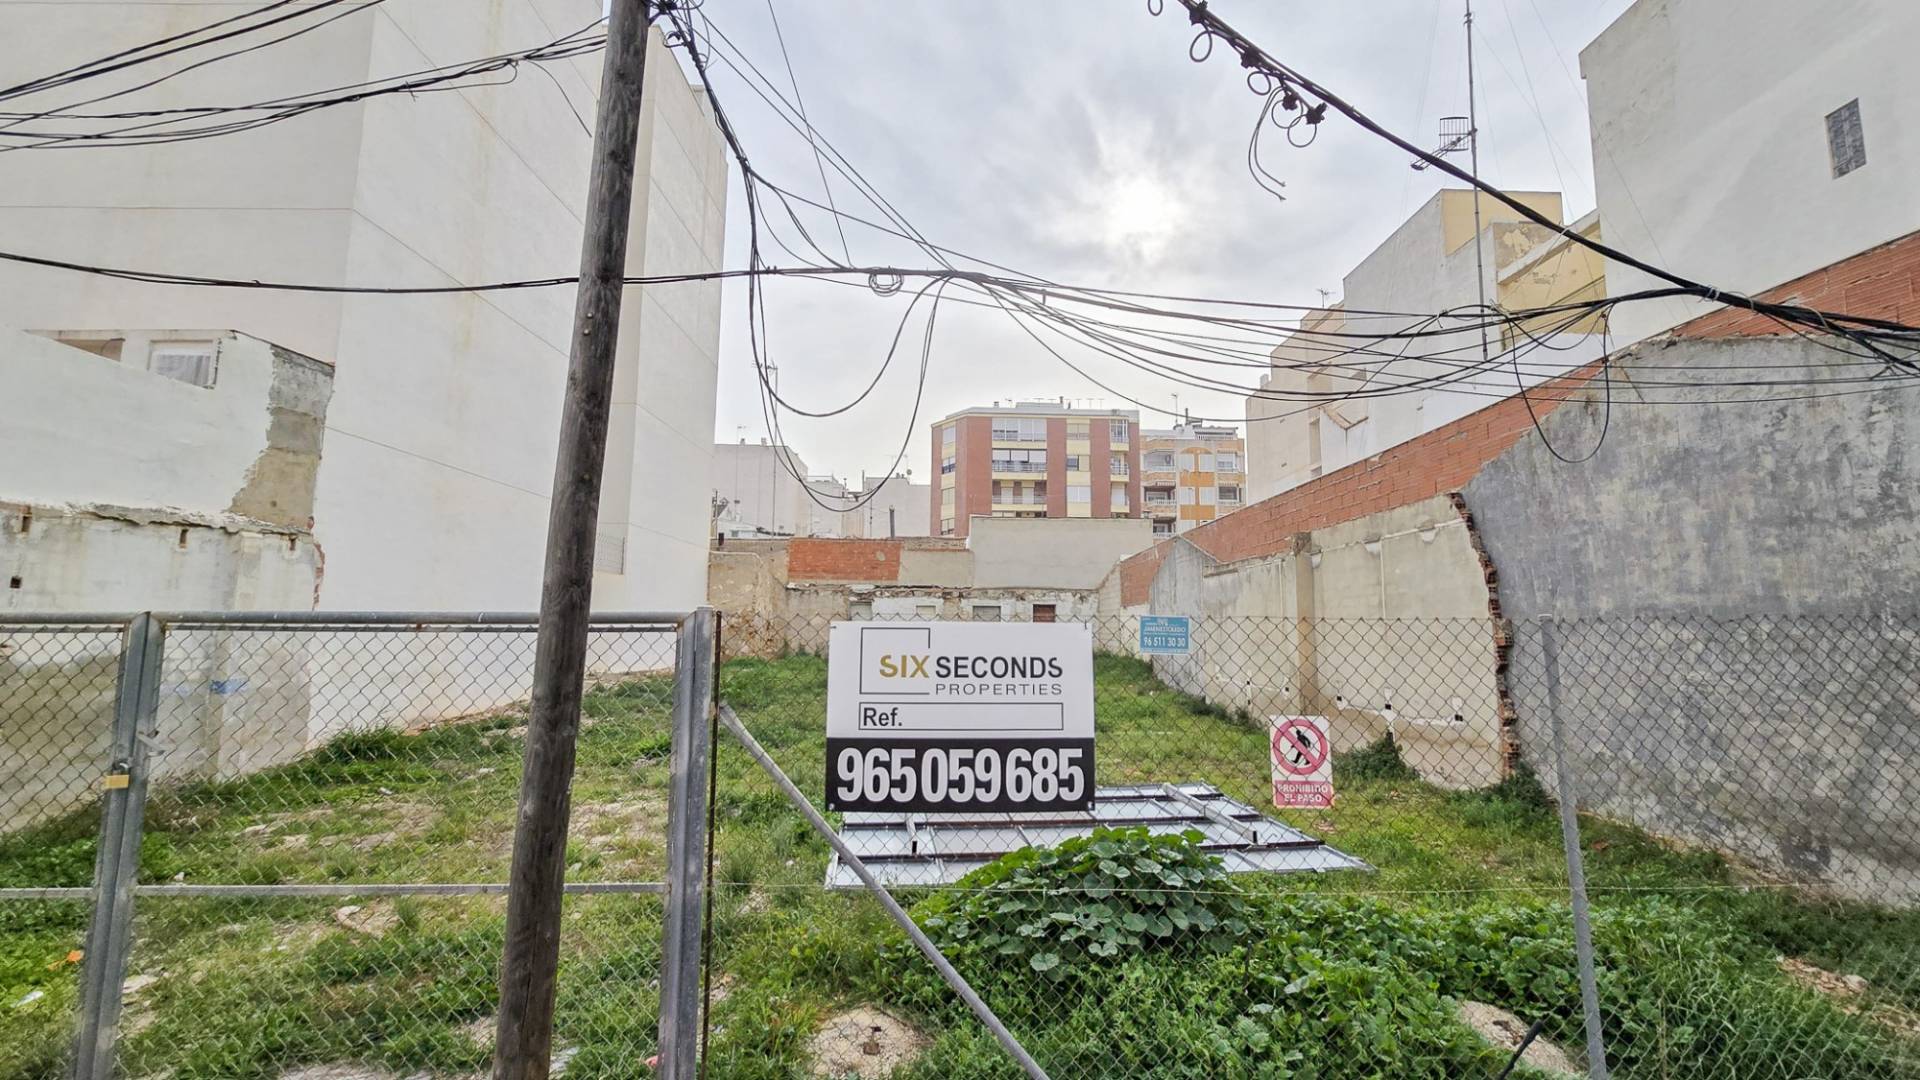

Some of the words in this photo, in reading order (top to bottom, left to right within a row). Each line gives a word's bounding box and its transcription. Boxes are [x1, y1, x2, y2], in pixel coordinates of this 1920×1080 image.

[1144, 636, 1152, 647] 96
[1153, 636, 1166, 647] 511
[879, 655, 930, 678] SIX
[935, 656, 1063, 679] SECONDS
[935, 683, 1062, 695] PROPERTIES
[863, 707, 903, 727] Ref.
[837, 747, 917, 802] 965
[921, 748, 1000, 802] 059
[1005, 748, 1085, 802] 685
[1277, 783, 1329, 793] PROHIBIDO
[1284, 793, 1296, 802] EL
[1297, 793, 1323, 802] PASO
